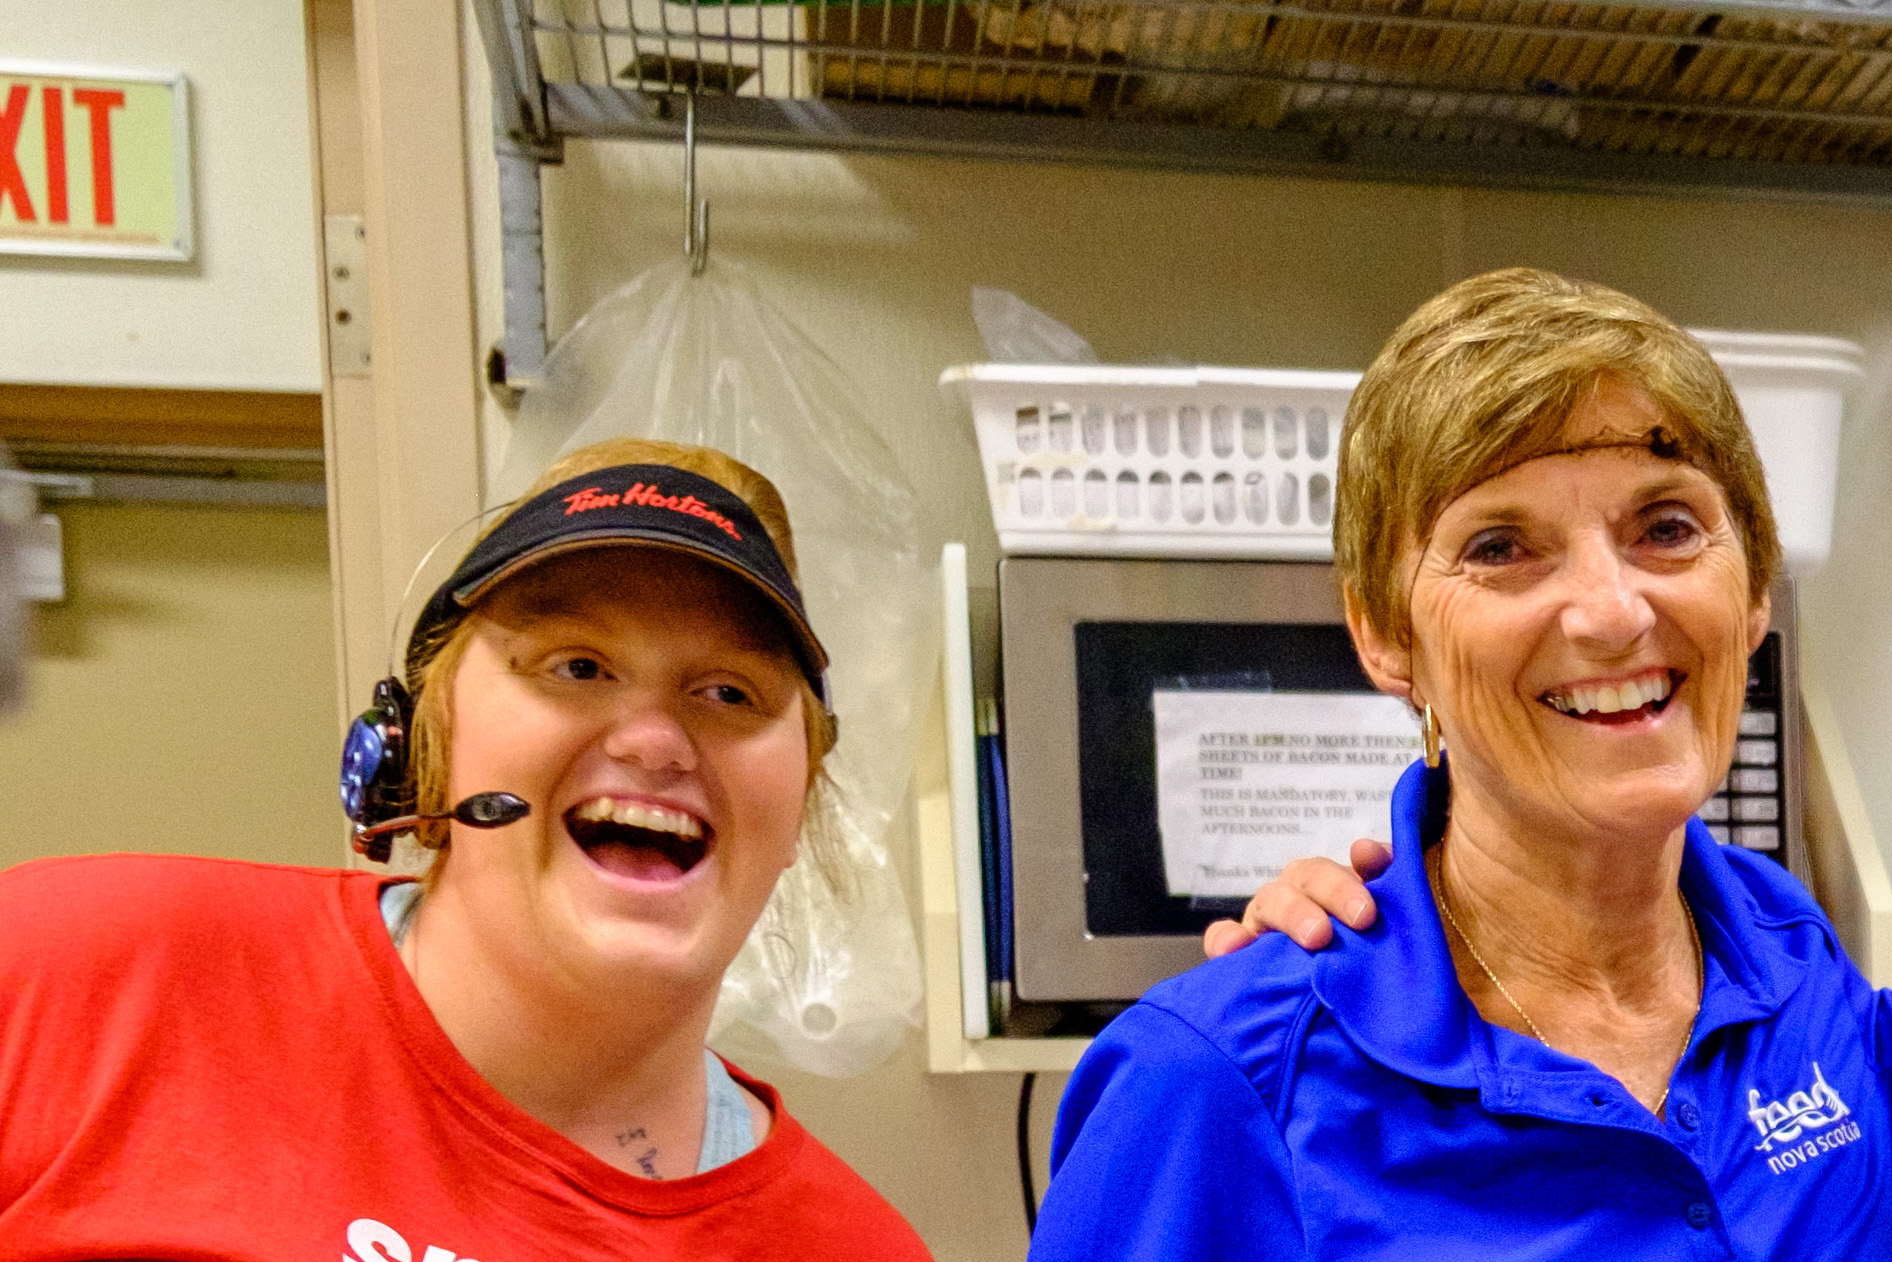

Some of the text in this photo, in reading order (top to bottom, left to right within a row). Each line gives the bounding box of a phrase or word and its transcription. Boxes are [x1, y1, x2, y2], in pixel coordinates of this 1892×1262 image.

[563, 482, 742, 541] Tim Hortons
[1200, 732, 1249, 746] AFTER
[1289, 733, 1311, 747] NO
[1315, 734, 1360, 748] MORE
[1365, 734, 1405, 748] THEN
[1200, 750, 1259, 763] SHEETS
[1263, 751, 1284, 763] OF
[1288, 751, 1340, 764] BACON
[1345, 752, 1388, 765] MADE
[1201, 788, 1234, 800] THIS
[1238, 788, 1252, 800] IS
[1201, 806, 1353, 819] MUCH BACON IN THE
[1767, 1121, 1862, 1175] nova scotia
